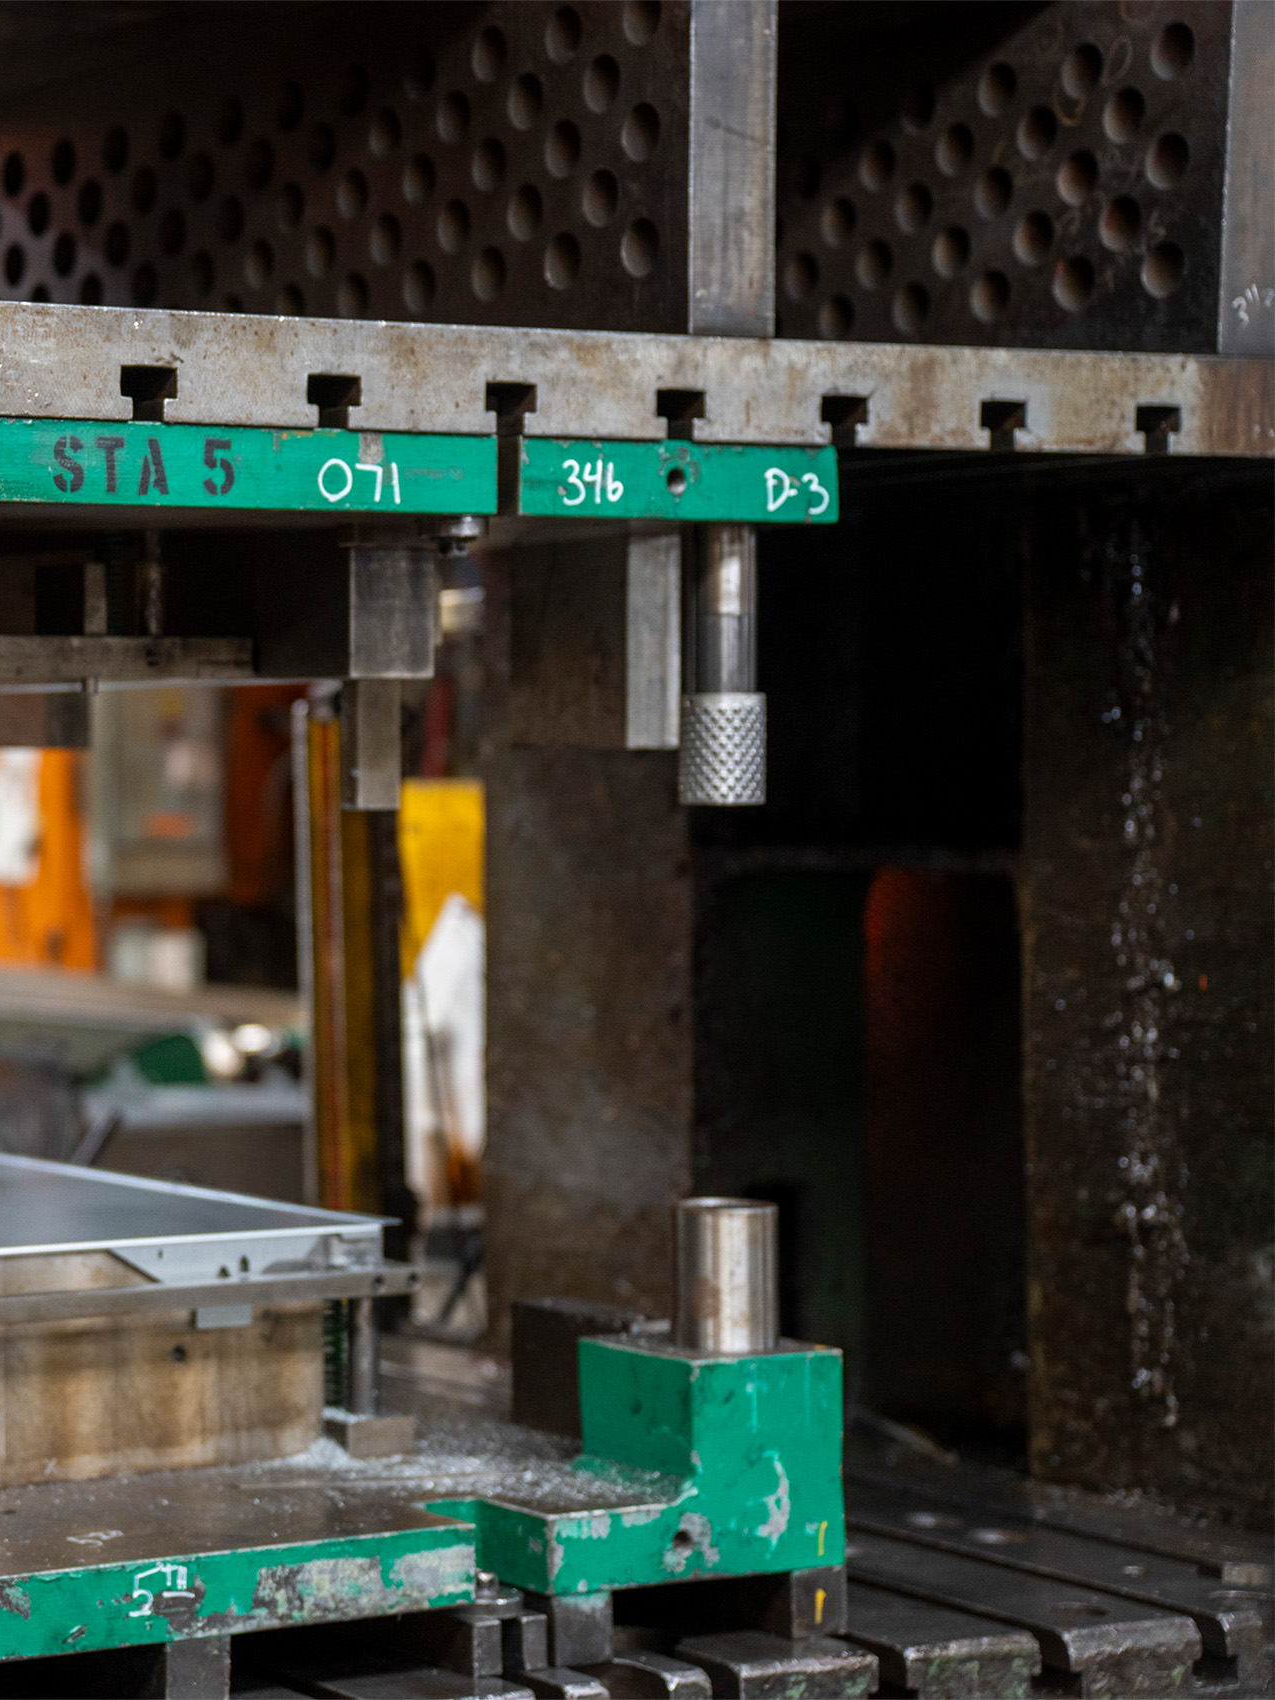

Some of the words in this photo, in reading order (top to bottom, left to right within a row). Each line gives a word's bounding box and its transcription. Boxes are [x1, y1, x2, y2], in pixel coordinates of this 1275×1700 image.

[52, 435, 170, 496] STA
[202, 437, 236, 497] 5
[317, 457, 402, 505] 071
[561, 458, 625, 506] 346
[765, 467, 831, 516] D-3
